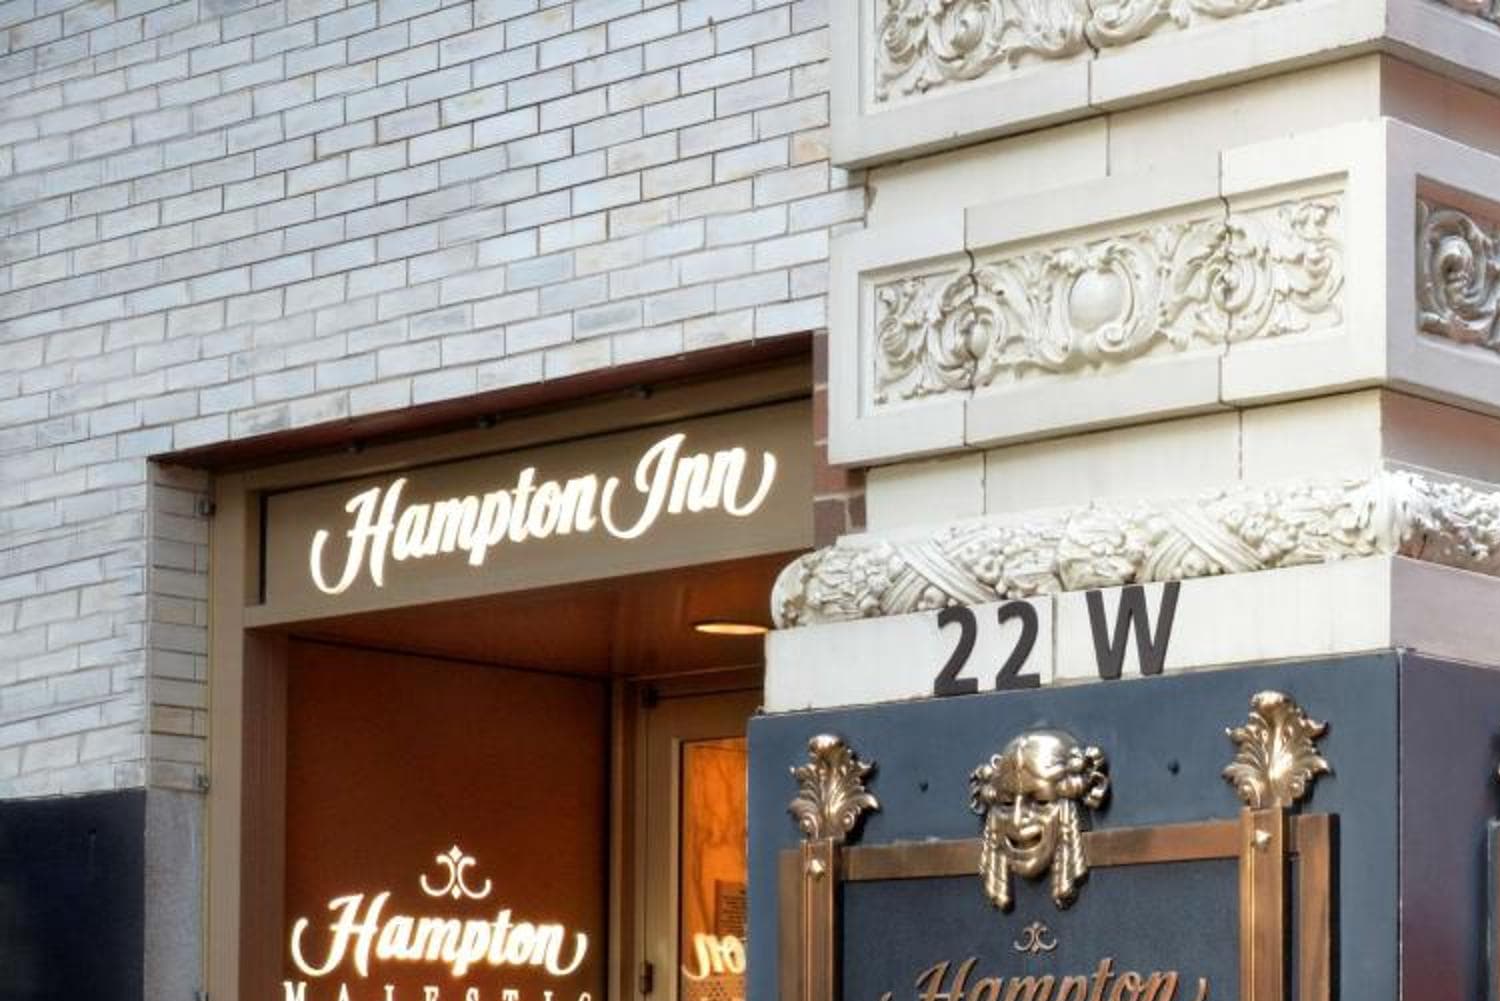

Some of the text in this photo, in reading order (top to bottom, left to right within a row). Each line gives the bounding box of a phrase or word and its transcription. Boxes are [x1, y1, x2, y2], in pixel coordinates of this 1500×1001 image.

[310, 433, 778, 595] Hampton Inn
[933, 581, 1182, 698] 22 W
[290, 890, 589, 978] Hampton
